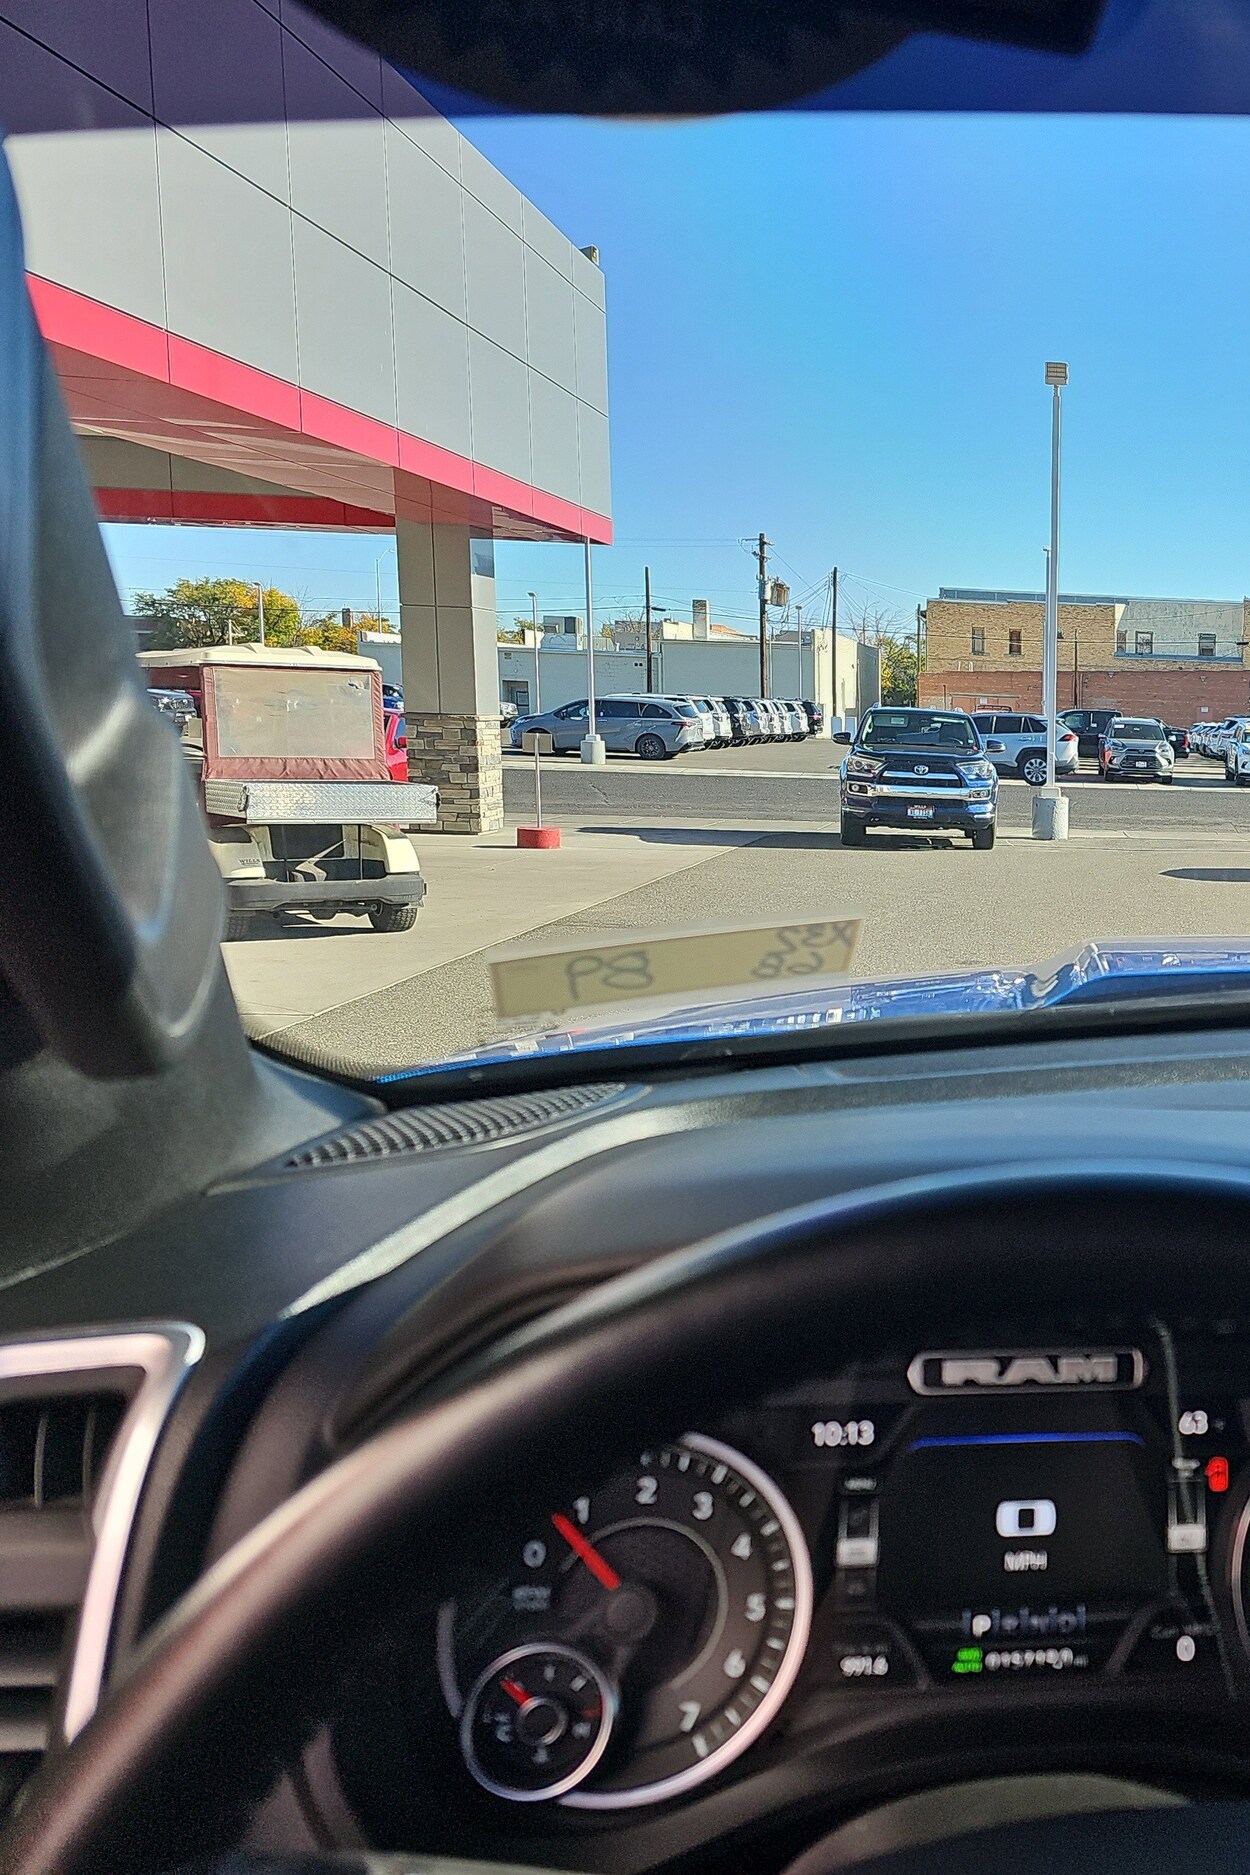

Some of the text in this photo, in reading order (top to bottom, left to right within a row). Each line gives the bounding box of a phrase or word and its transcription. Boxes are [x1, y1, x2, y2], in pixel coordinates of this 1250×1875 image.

[942, 1354, 1118, 1387] RAM
[811, 1420, 875, 1447] 10:13
[635, 1475, 658, 1505] 2
[573, 1496, 590, 1524] 1
[692, 1491, 714, 1521] 3
[995, 1498, 1057, 1538] 0
[523, 1539, 547, 1568] 0
[731, 1532, 752, 1561] 4
[744, 1592, 767, 1622] 5
[972, 1614, 992, 1638] P
[723, 1648, 746, 1679] 6
[679, 1701, 702, 1732] 7
